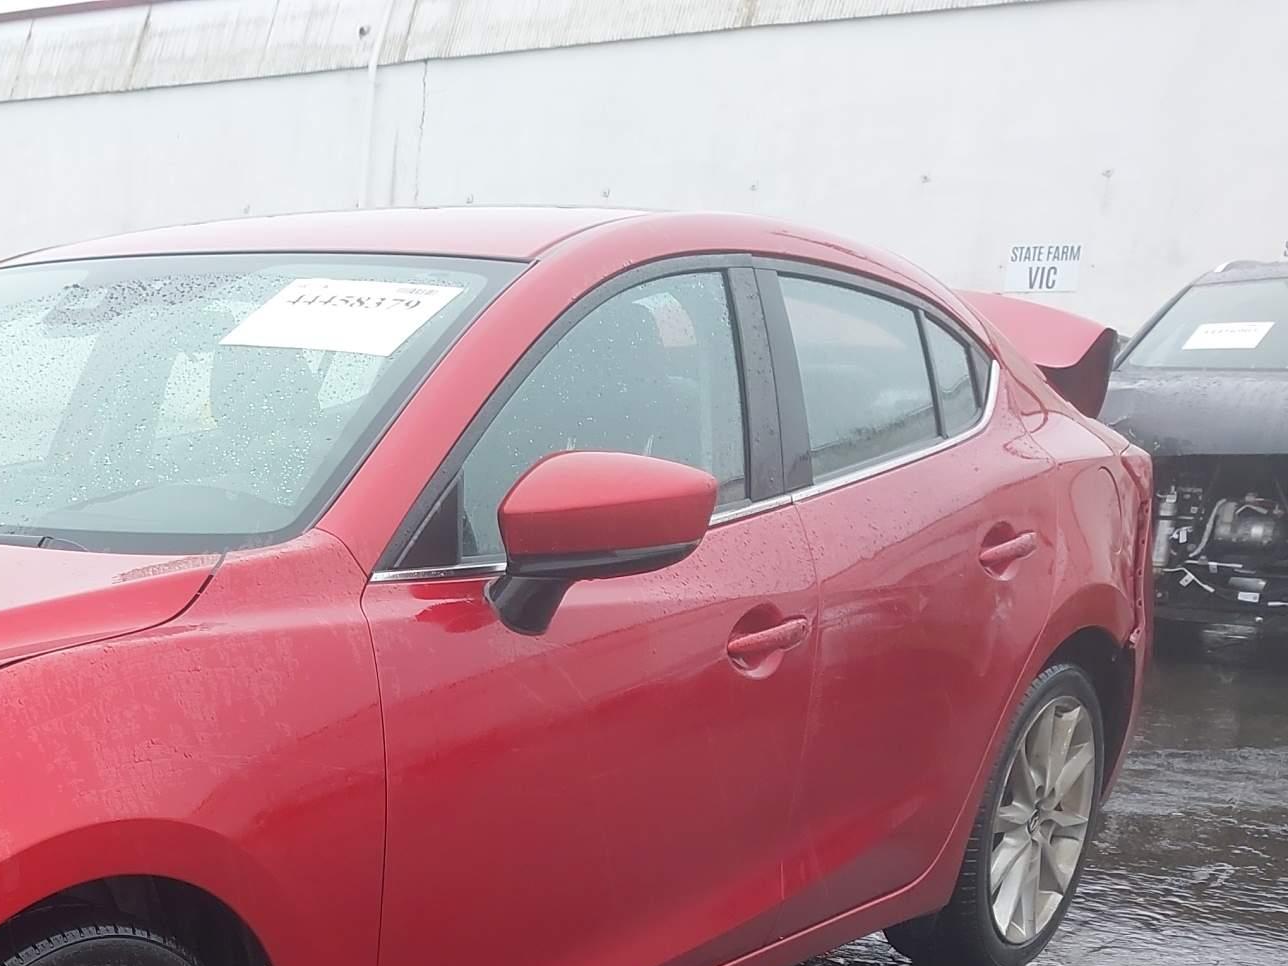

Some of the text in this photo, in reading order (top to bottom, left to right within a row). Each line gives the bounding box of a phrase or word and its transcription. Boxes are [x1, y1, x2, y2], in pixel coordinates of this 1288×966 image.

[1011, 245, 1081, 262] STATE FARM
[1028, 266, 1057, 289] VIC
